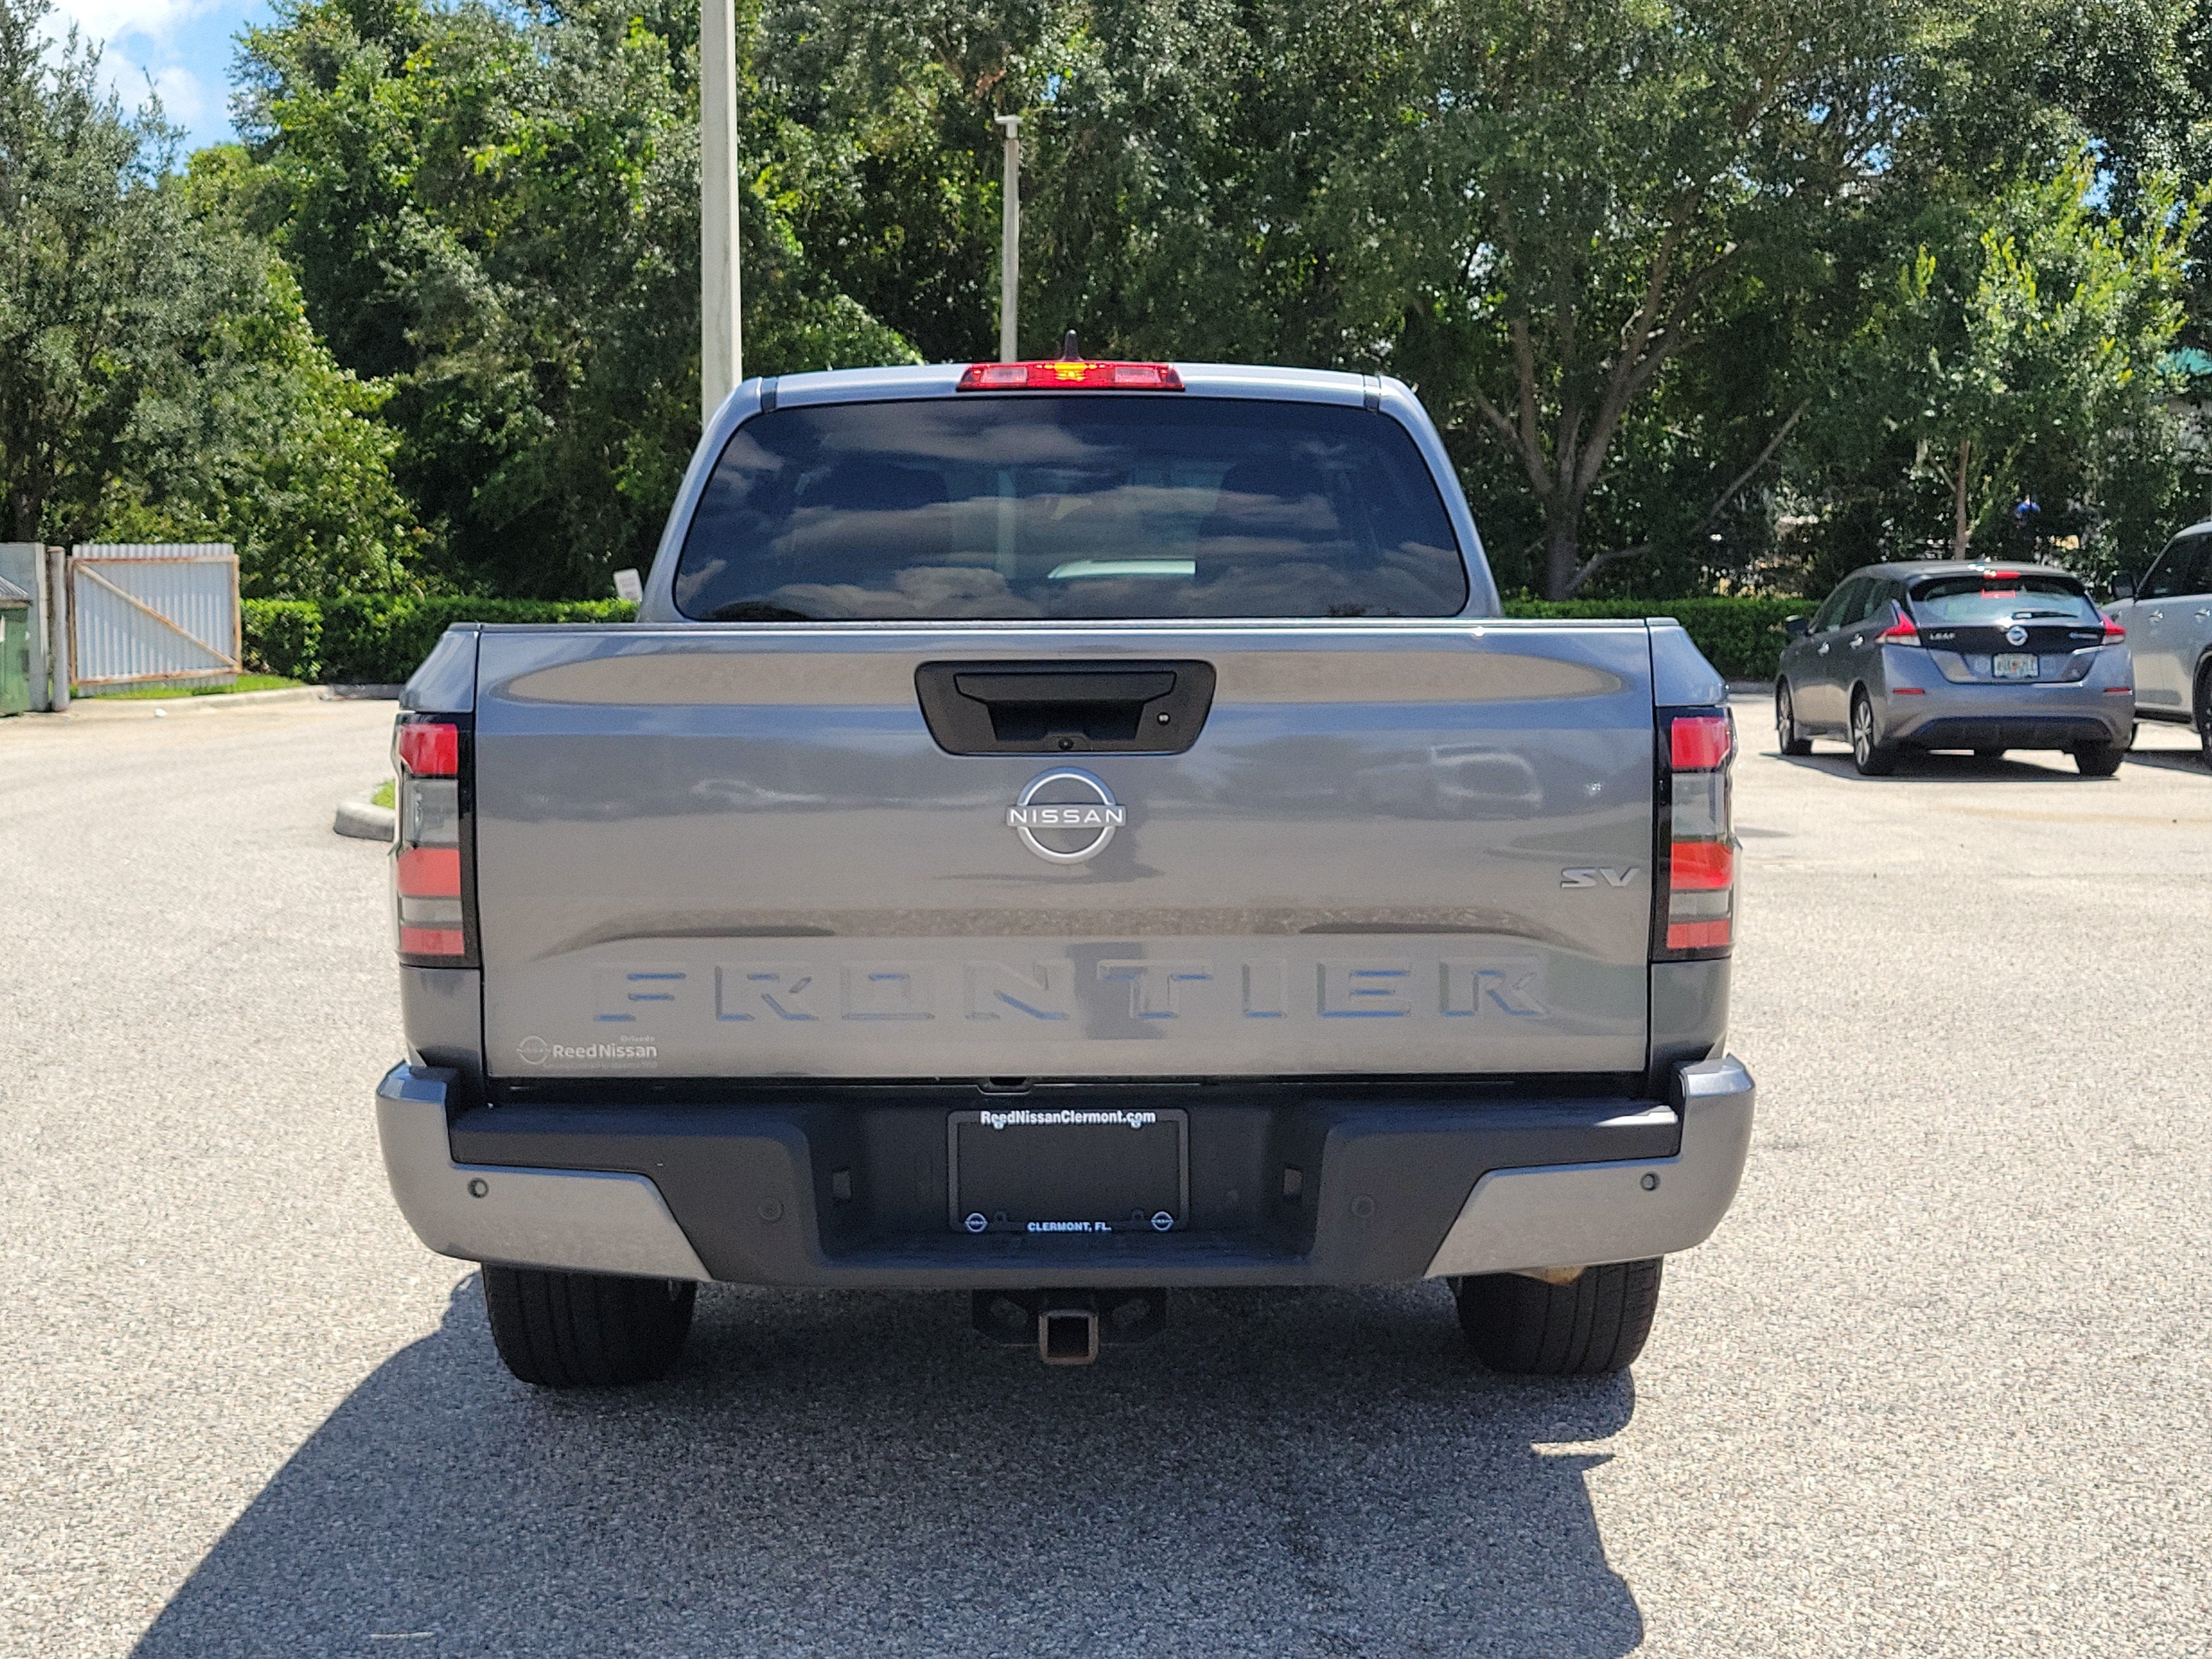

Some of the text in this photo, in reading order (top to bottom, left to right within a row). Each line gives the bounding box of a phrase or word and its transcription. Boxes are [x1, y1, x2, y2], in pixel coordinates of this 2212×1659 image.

[1010, 809, 1122, 823] NISSAN
[1561, 866, 1640, 887] SV
[594, 958, 1549, 1020] FRONTIER
[1027, 1222, 1112, 1232] CLERMONT, FL.
